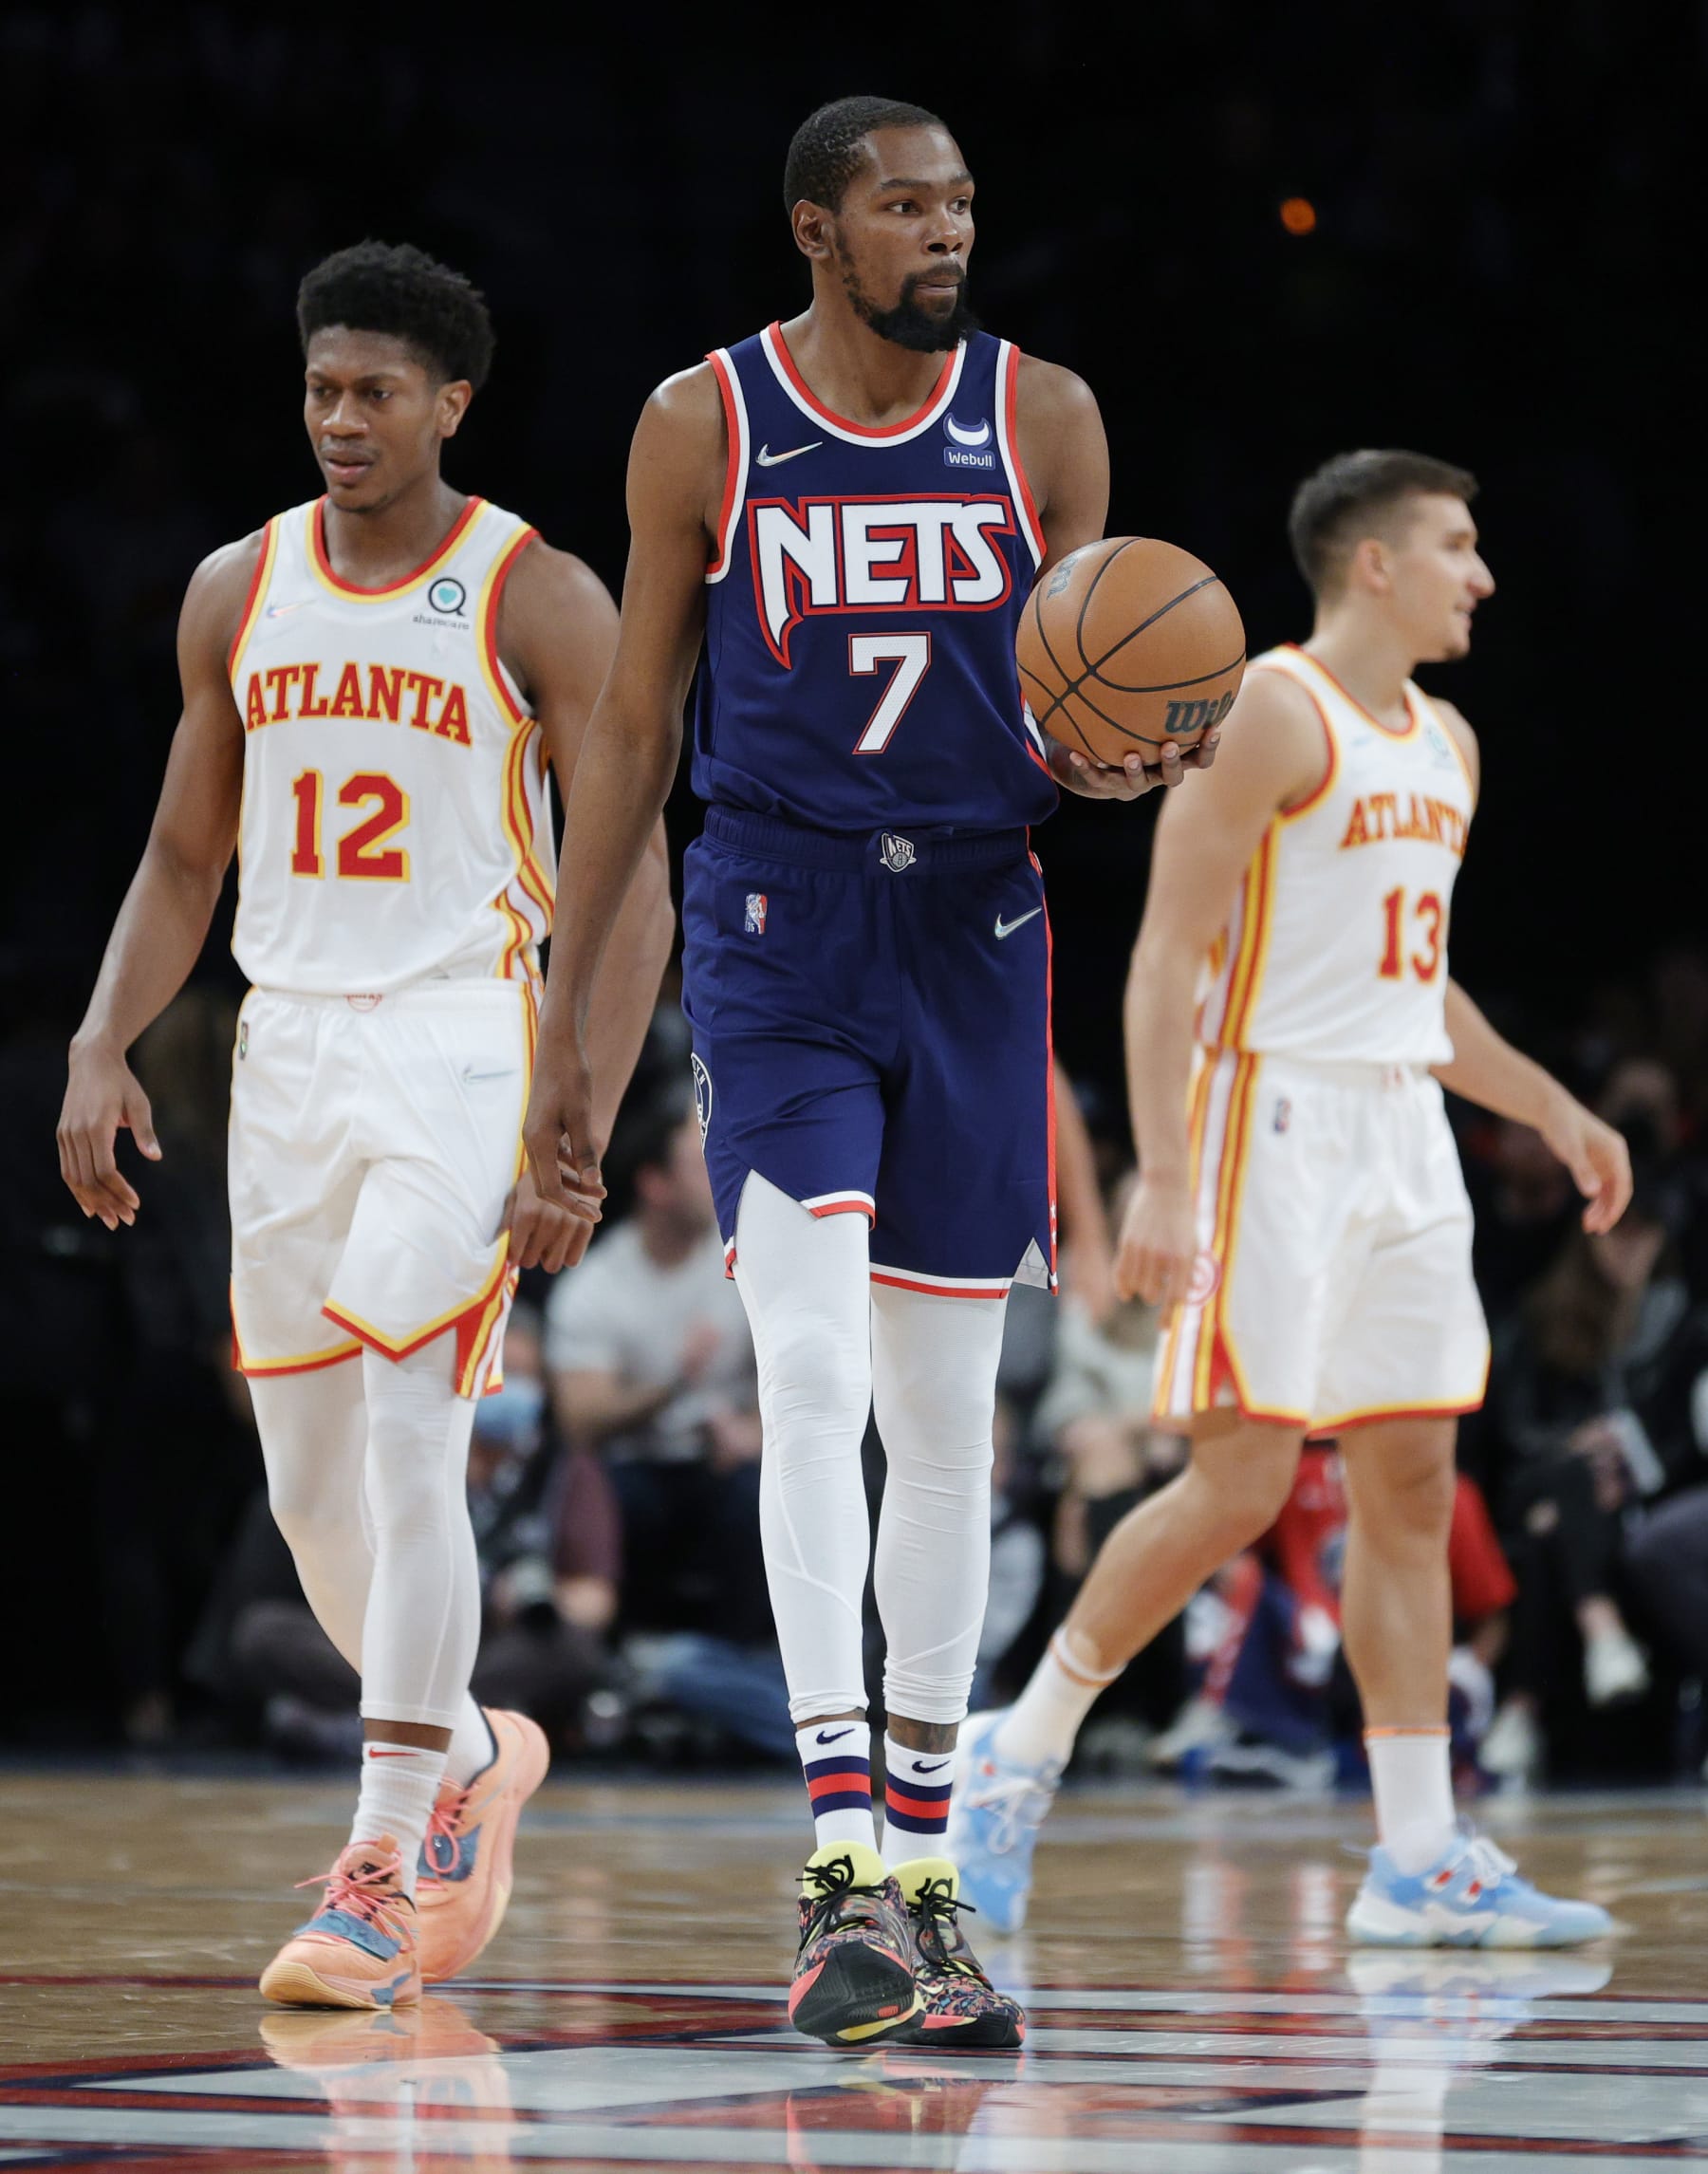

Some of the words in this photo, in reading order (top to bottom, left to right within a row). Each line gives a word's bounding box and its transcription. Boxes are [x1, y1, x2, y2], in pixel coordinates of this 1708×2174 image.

[949, 451, 993, 468] Webull
[747, 493, 1017, 670] NETS
[247, 661, 473, 748] ATLANTA
[847, 631, 932, 755] 7
[1164, 690, 1236, 734] Wil
[290, 767, 411, 883] 12
[887, 836, 913, 858] NETS
[1379, 884, 1443, 986] 13
